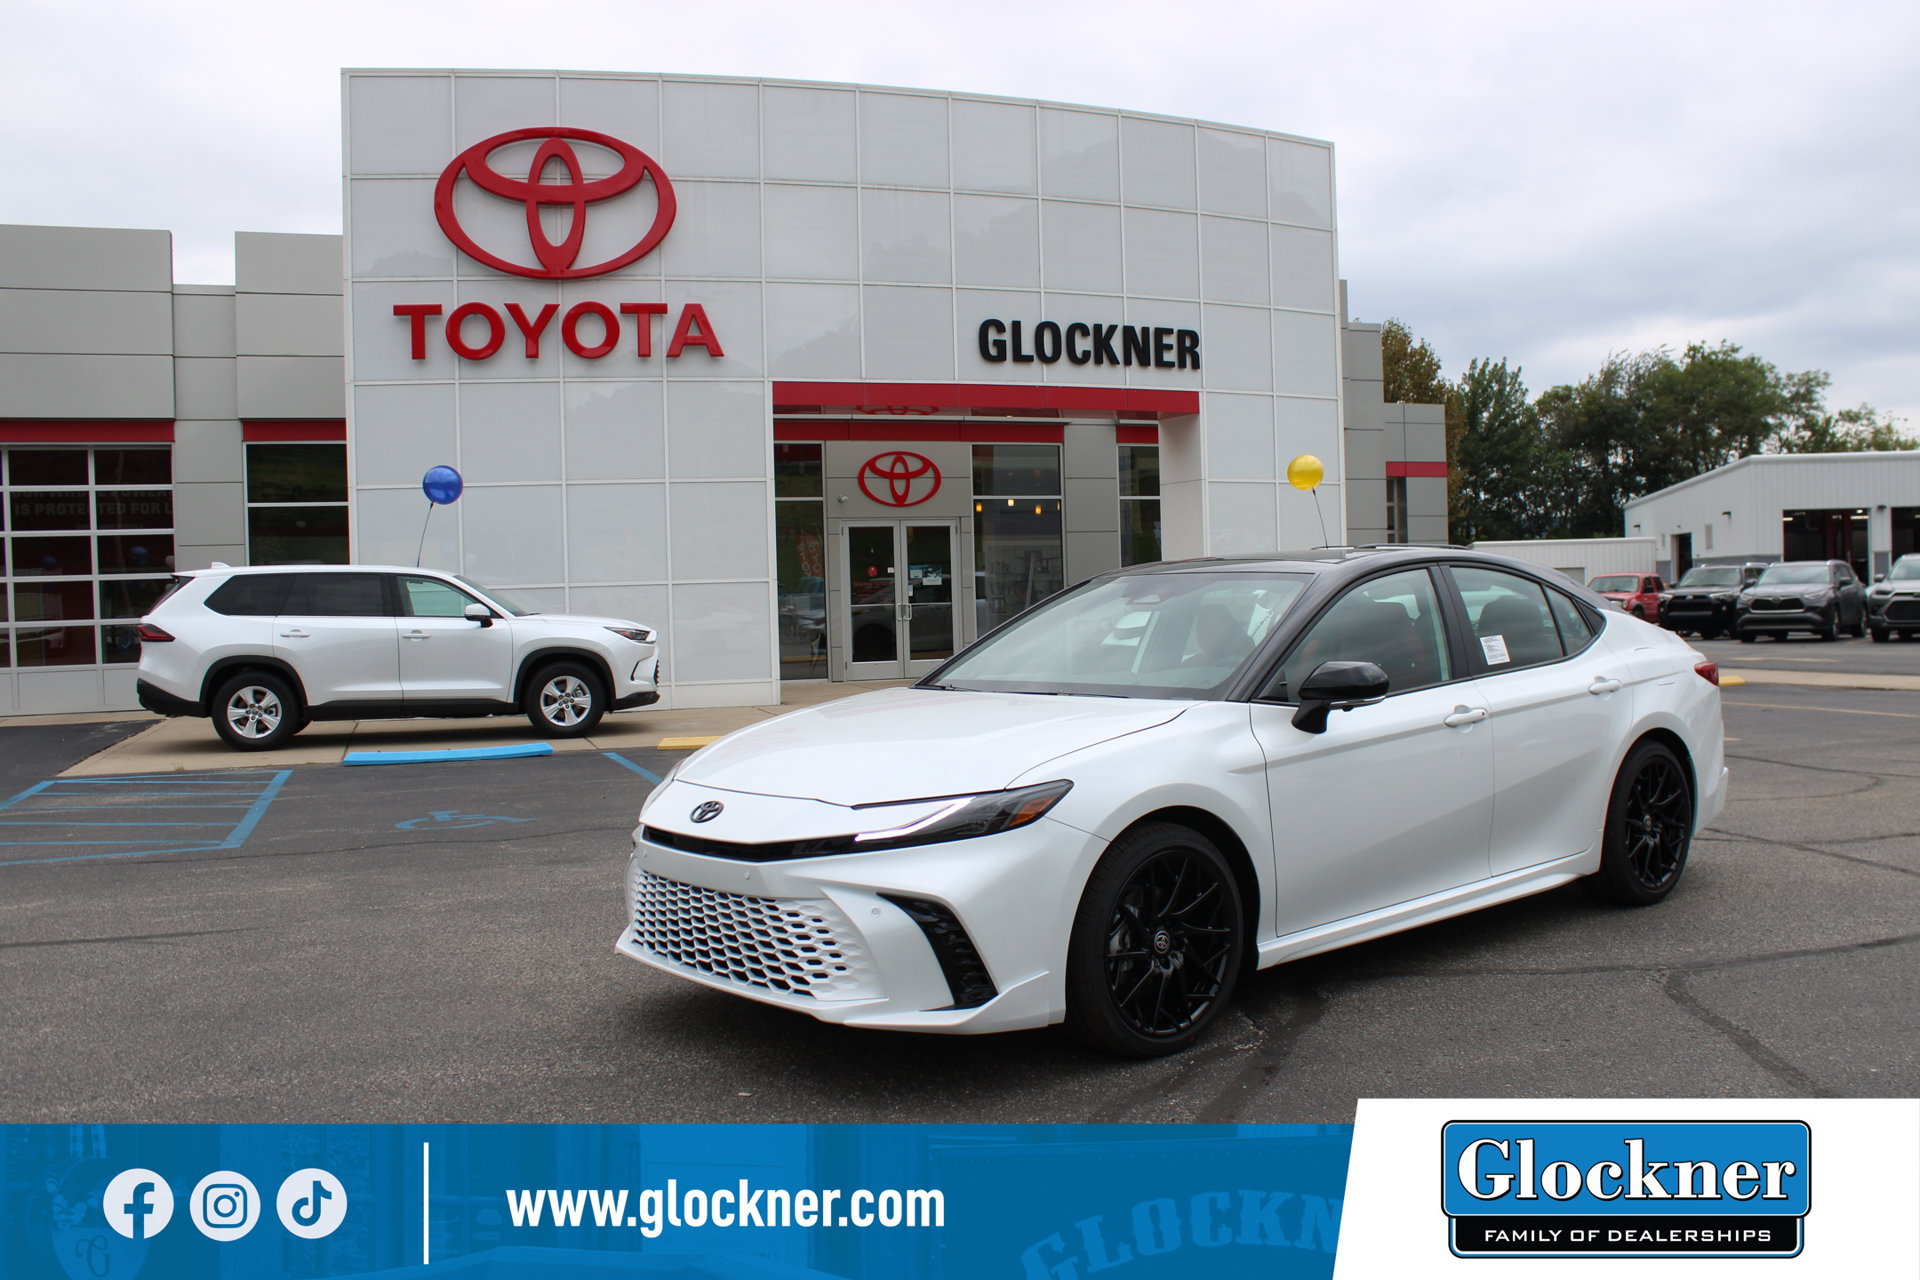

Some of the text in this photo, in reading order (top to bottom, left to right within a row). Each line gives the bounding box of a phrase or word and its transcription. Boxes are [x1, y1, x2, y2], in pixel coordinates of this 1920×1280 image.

[393, 301, 725, 361] TOYOTA
[978, 318, 1201, 370] GLOCKNER
[14, 503, 30, 515] IS
[35, 502, 126, 515] PROTETED
[130, 502, 161, 514] FOR
